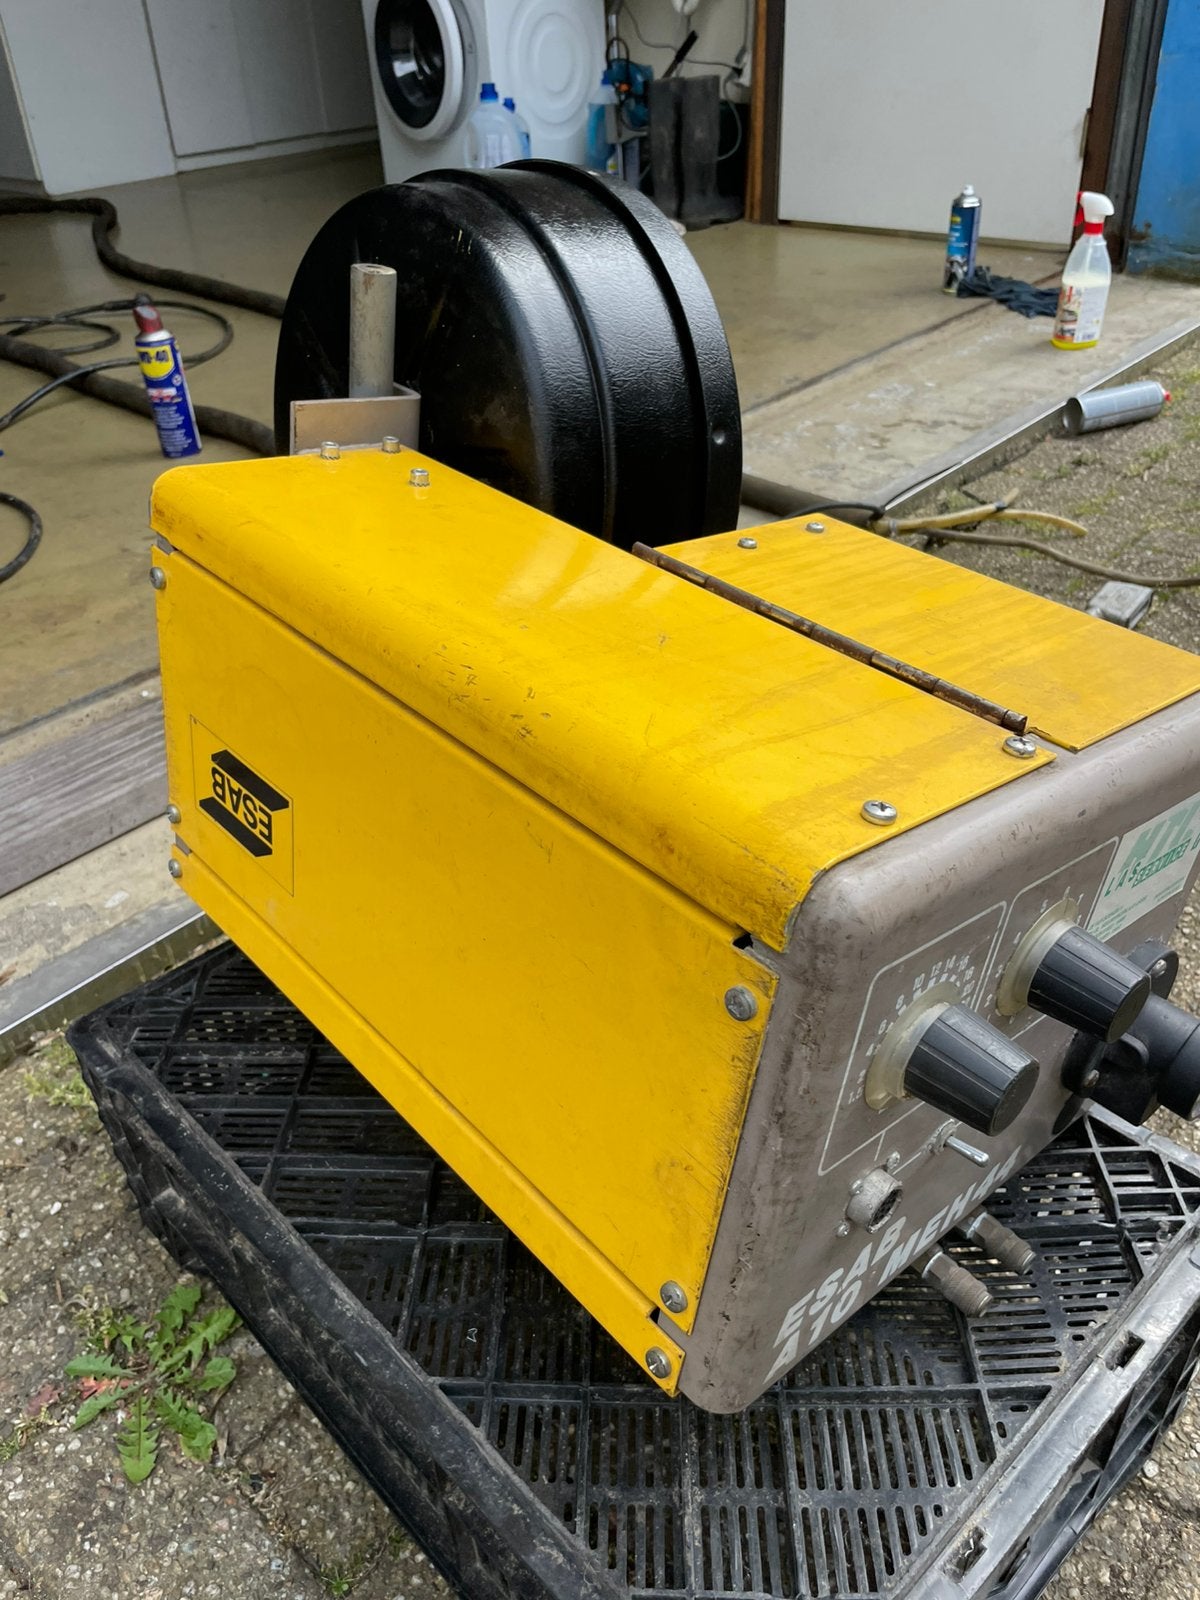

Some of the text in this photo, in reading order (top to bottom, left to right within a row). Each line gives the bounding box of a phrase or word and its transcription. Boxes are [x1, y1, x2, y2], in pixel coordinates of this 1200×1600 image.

[211, 767, 272, 844] ESAB
[931, 962, 942, 977] 12
[913, 973, 925, 990] 10
[896, 994, 905, 1010] 8
[878, 1019, 887, 1035] 6
[866, 1043, 874, 1057] 4
[773, 1216, 906, 1348] ESAB
